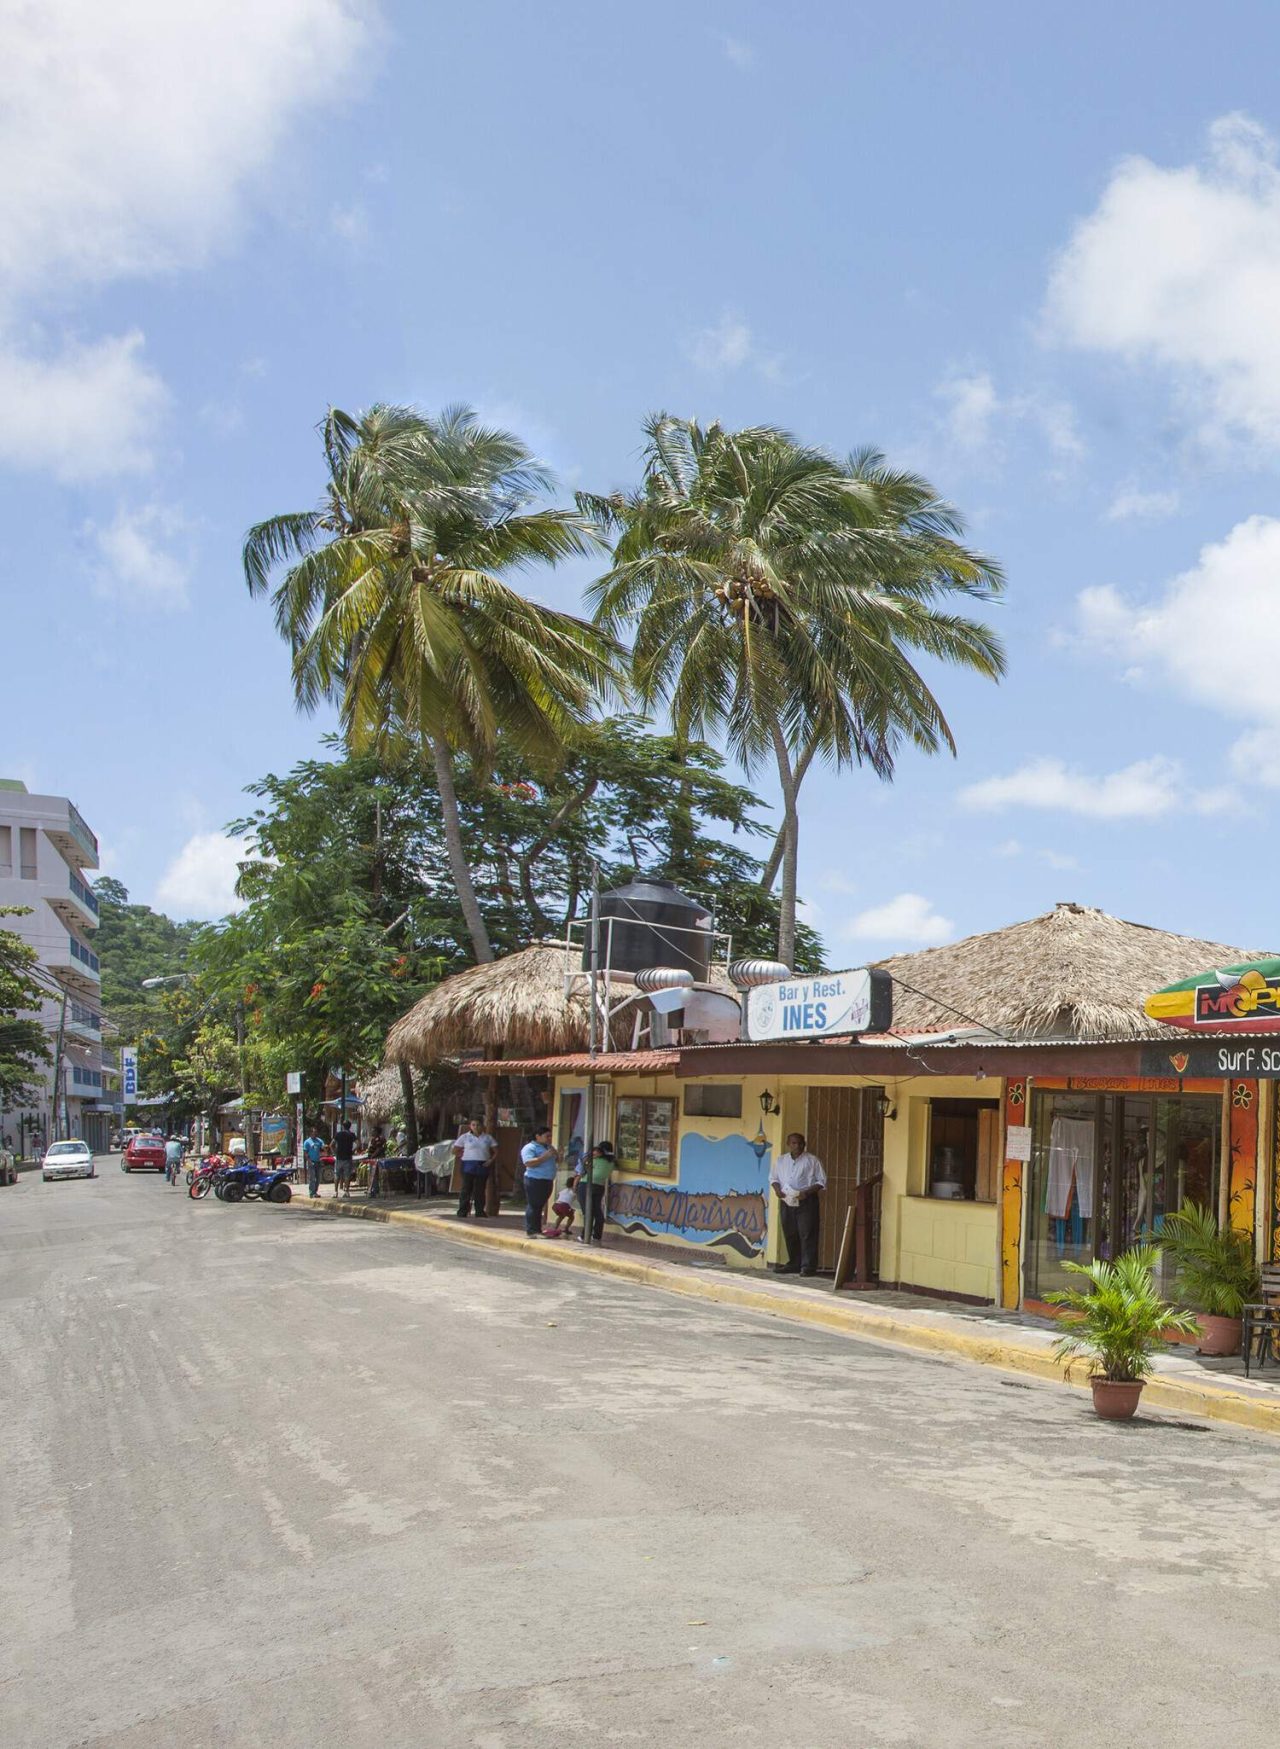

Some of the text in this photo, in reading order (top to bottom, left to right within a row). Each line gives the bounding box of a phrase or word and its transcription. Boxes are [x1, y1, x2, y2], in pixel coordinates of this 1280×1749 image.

[779, 979, 846, 1002] Bar y Rest.
[783, 1002, 827, 1031] INES
[125, 1058, 136, 1094] BDF
